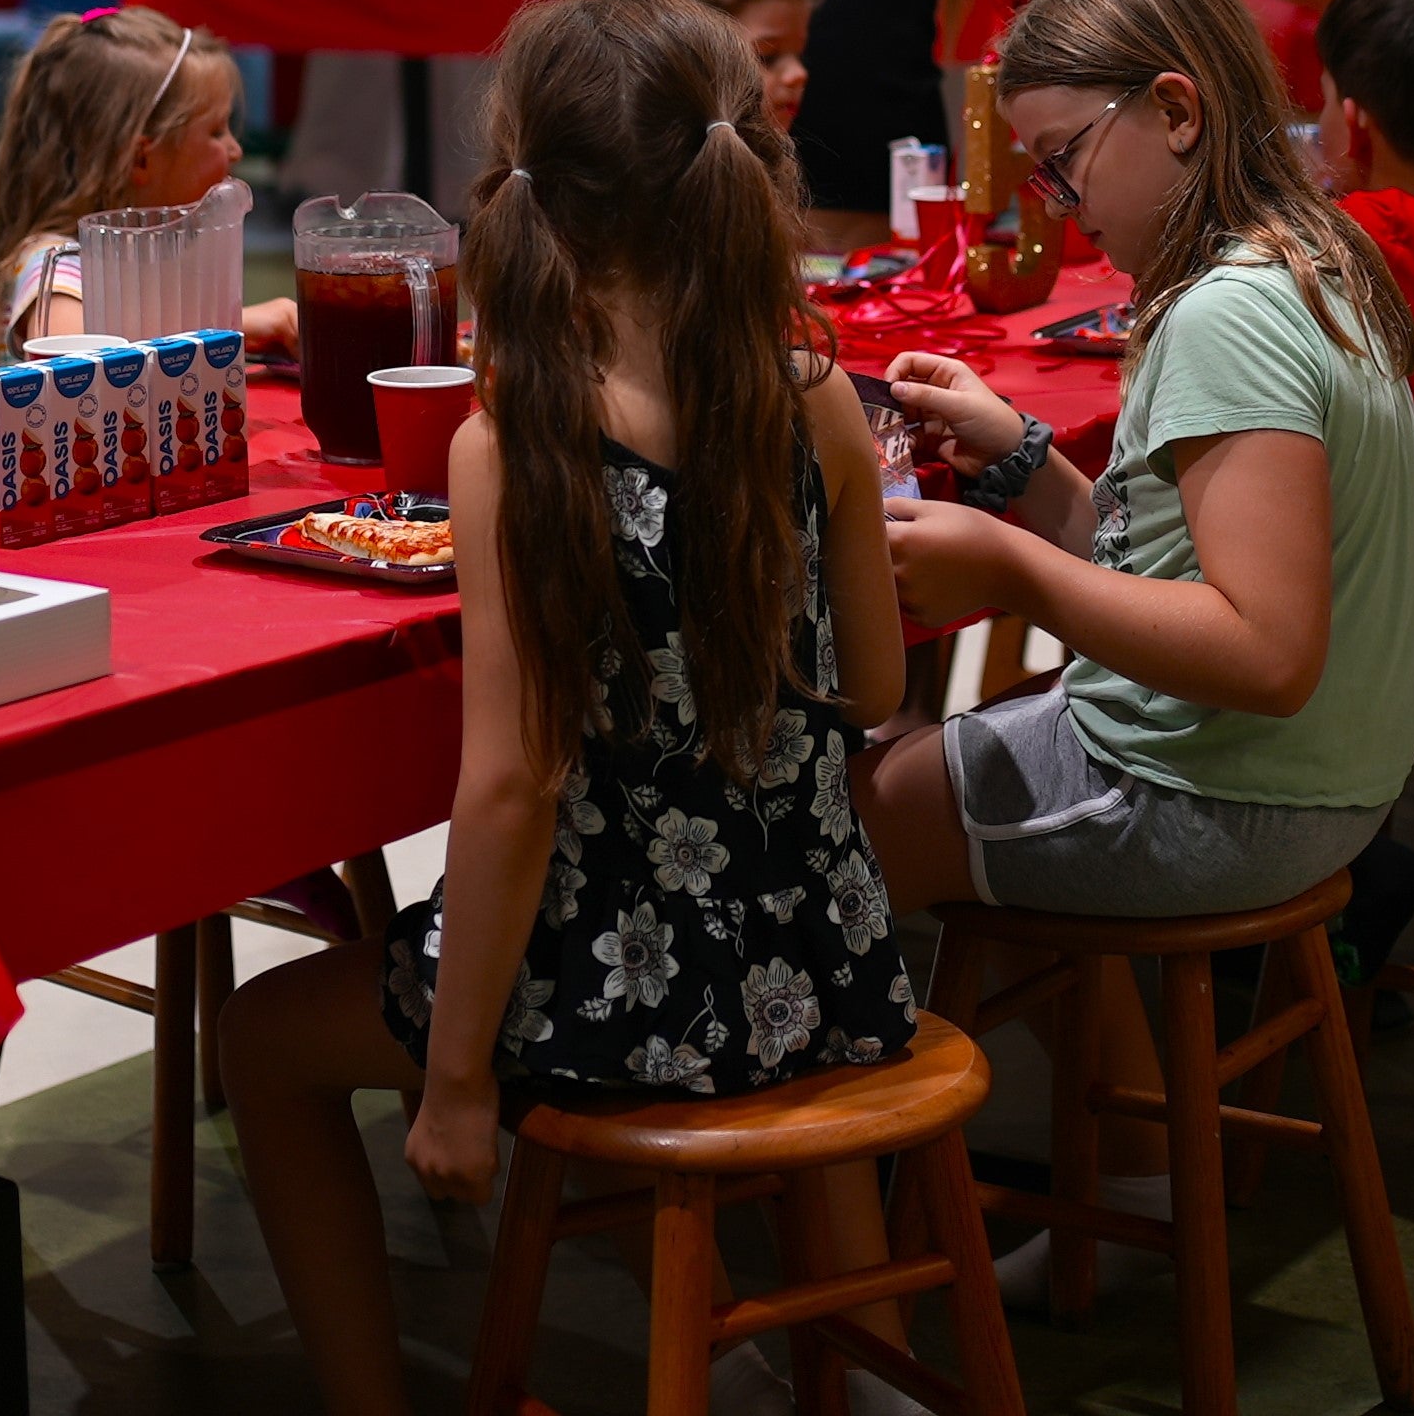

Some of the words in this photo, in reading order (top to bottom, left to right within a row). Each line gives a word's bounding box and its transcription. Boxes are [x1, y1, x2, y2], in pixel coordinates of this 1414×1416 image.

[55, 421, 69, 498] OASIS
[104, 410, 118, 487] OASIS
[158, 400, 173, 476] OASIS
[204, 391, 219, 465] OASIS
[2, 432, 16, 510] OASIS
